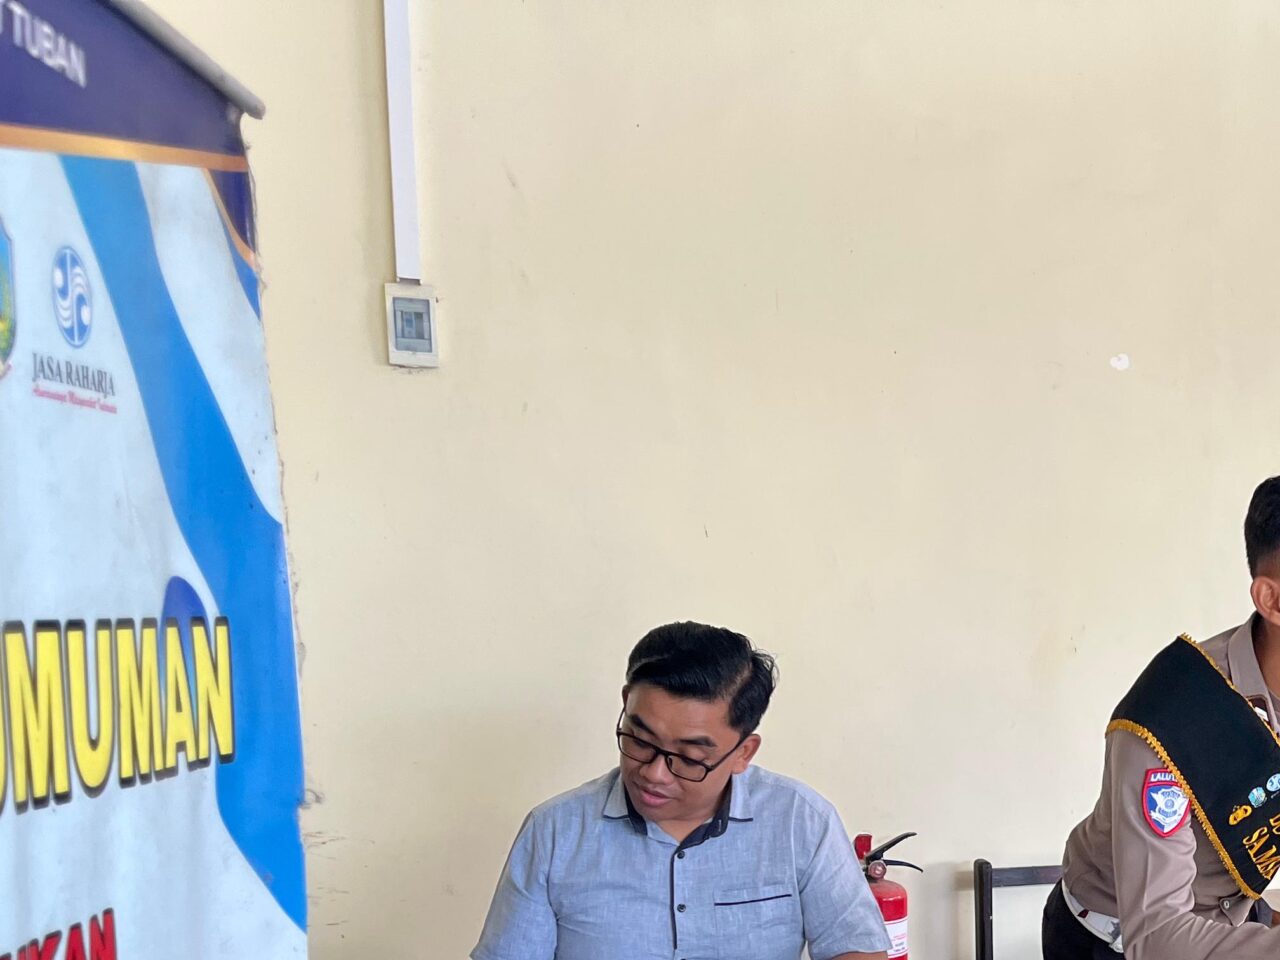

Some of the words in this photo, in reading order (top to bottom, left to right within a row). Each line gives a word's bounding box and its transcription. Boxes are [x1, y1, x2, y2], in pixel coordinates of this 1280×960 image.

[9, 0, 86, 88] TUBAN
[33, 353, 63, 383] JASA
[65, 361, 116, 399] RAHARJA
[0, 616, 235, 816] MUMAN
